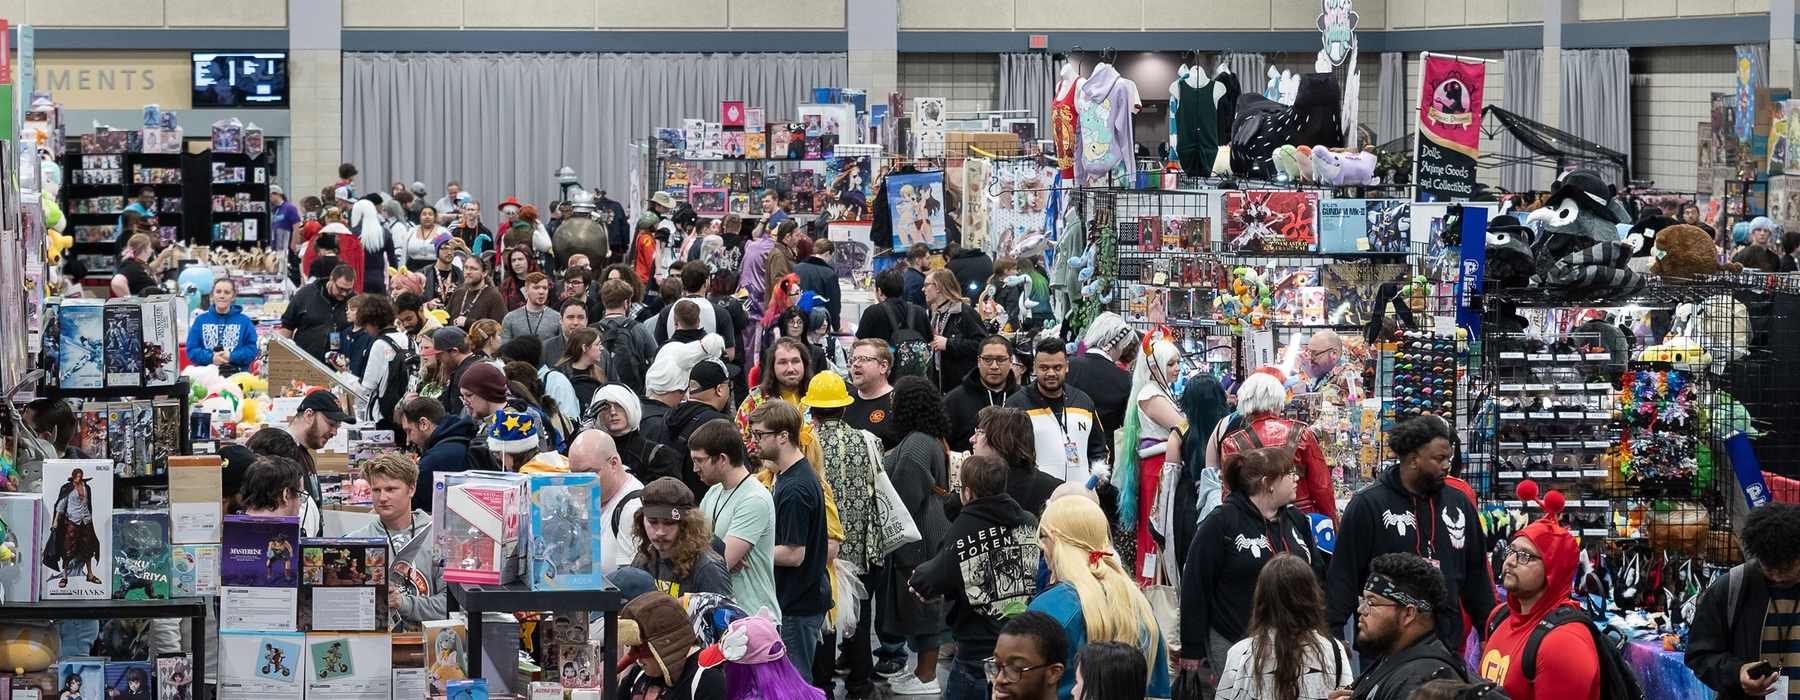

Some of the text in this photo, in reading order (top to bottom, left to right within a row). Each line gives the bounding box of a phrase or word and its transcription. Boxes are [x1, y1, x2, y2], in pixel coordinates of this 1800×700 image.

[1420, 160, 1468, 178] Anime Goods
[1420, 178, 1472, 194] and Collectibles
[1321, 207, 1349, 216] GUNDAM
[1328, 266, 1363, 274] UNICORN
[1078, 422, 1086, 431] N
[956, 525, 1007, 549] SLEEP
[957, 536, 1012, 561] TOKEN
[572, 577, 592, 585] AQUA
